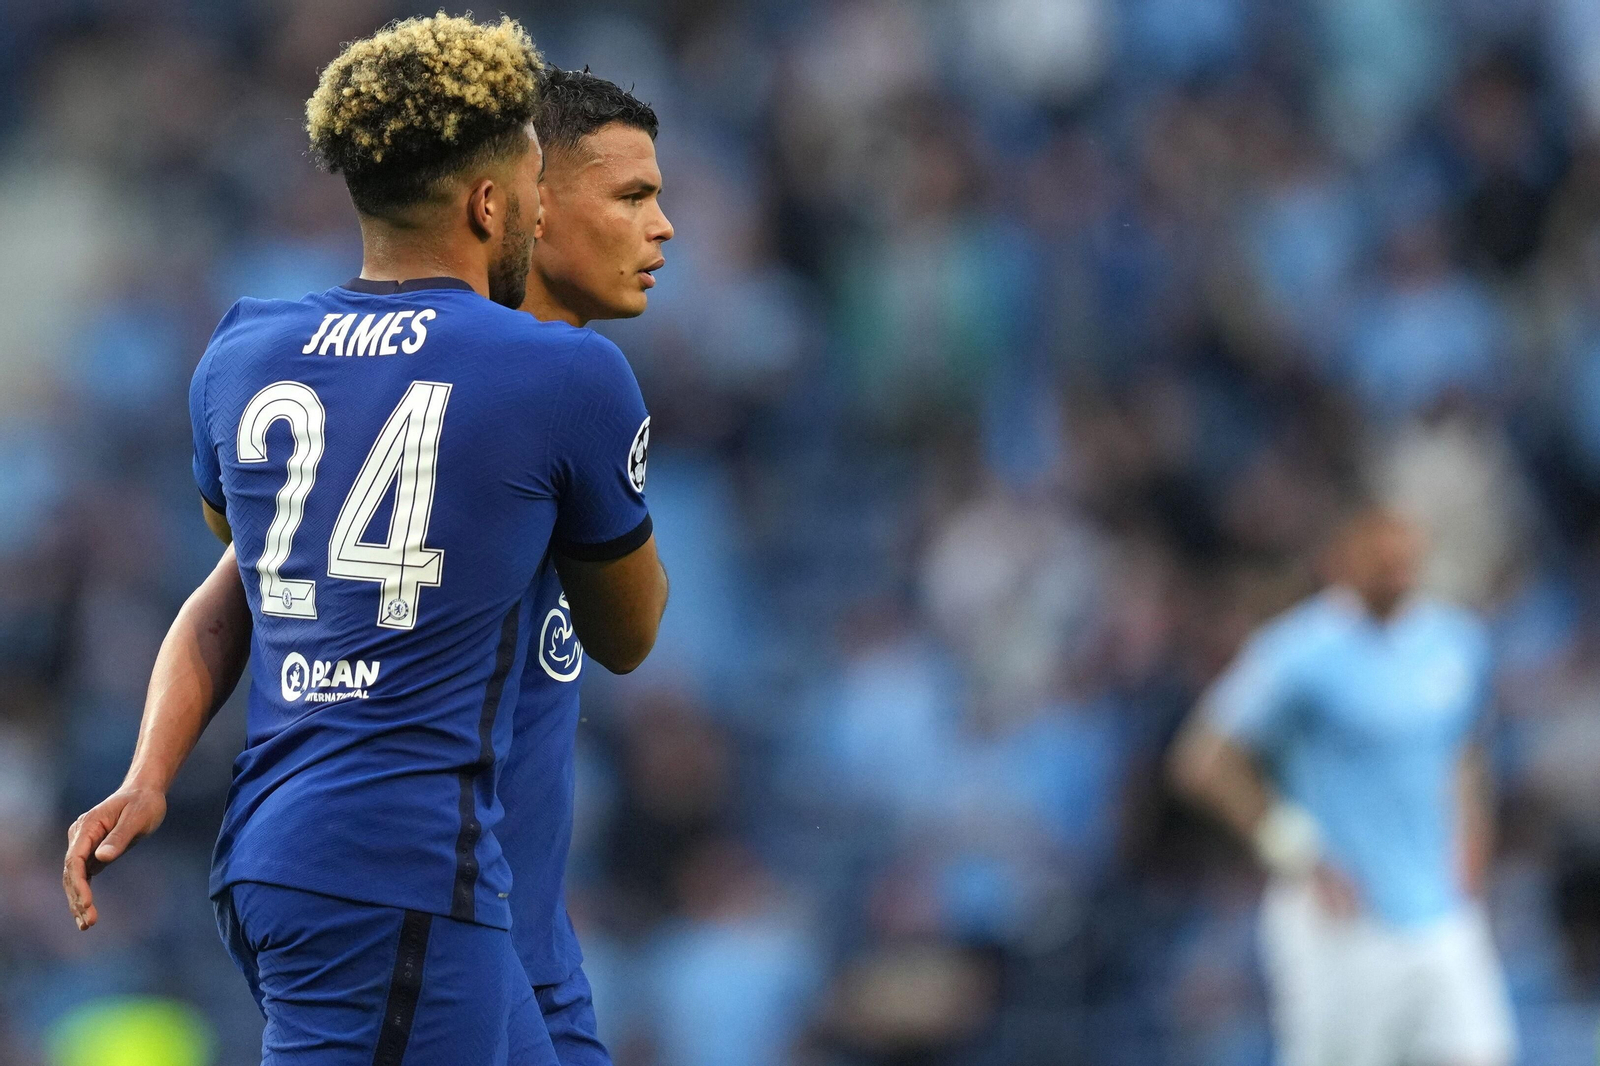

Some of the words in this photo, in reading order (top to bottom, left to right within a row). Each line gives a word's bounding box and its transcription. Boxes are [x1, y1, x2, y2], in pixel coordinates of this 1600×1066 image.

[302, 309, 436, 356] JAMES
[237, 380, 453, 630] 24
[311, 660, 380, 688] PLAN
